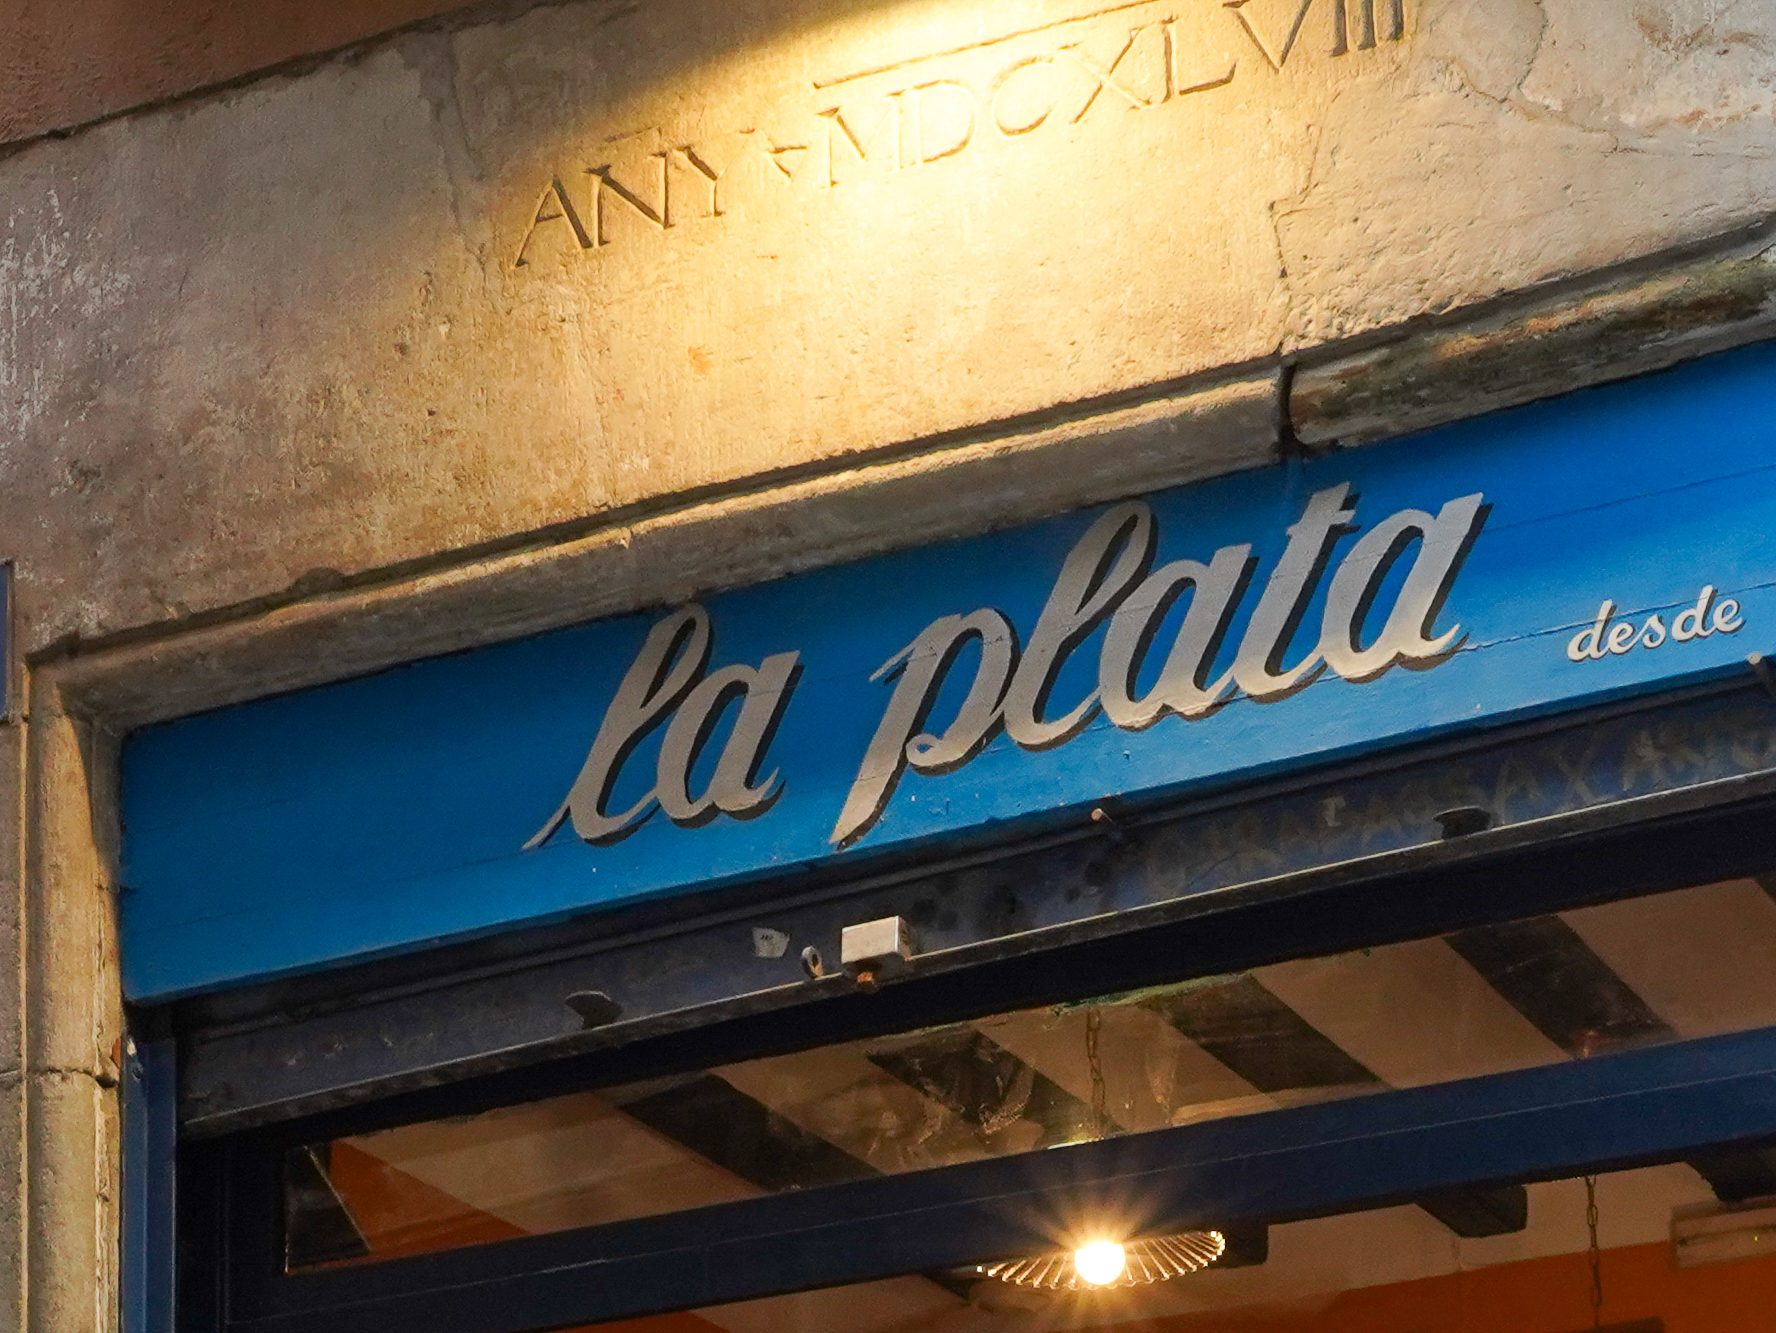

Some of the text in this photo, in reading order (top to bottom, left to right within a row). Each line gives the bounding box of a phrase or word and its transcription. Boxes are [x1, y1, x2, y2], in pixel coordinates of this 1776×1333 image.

[514, 143, 729, 267] ANY
[523, 603, 803, 850] la
[829, 480, 1491, 850] plata
[1567, 585, 1745, 661] desde
